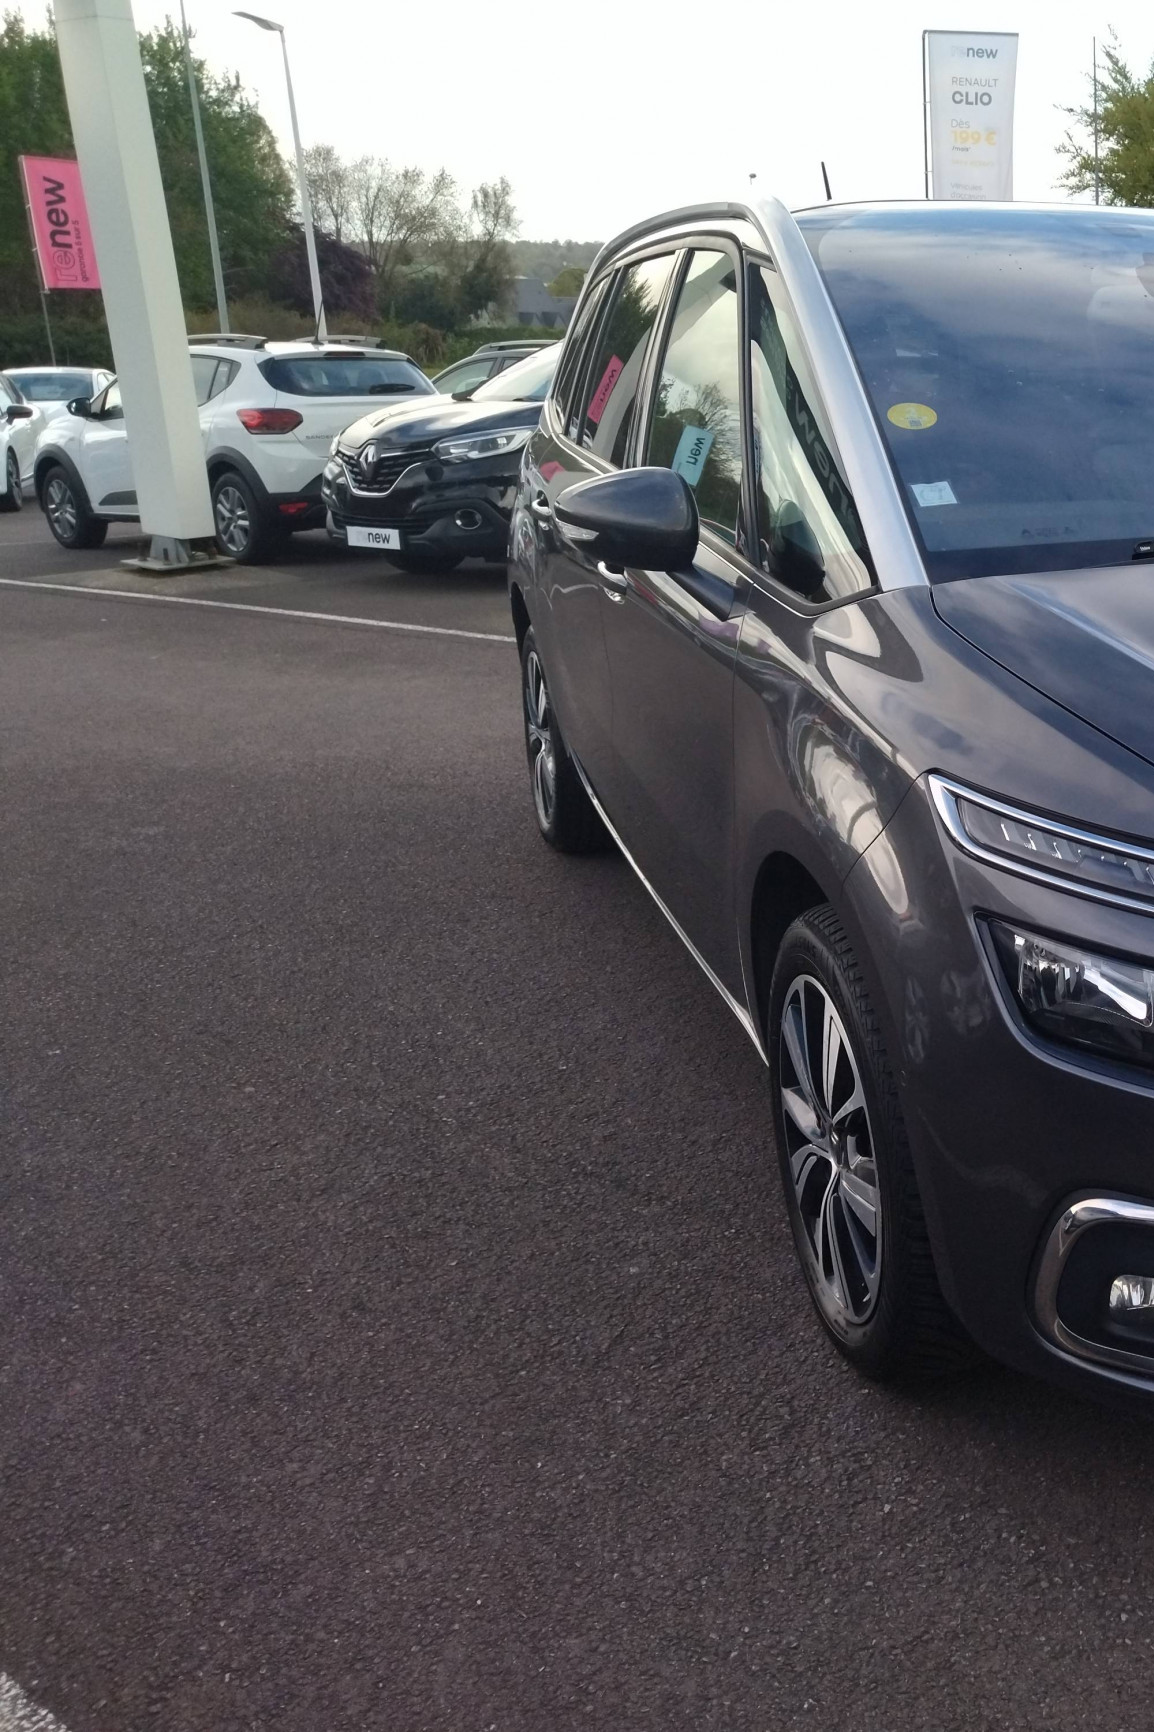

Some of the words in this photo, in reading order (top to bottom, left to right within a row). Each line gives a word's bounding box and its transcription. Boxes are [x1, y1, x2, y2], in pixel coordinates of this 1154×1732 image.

[951, 76, 999, 89] RENAULT
[951, 90, 993, 106] CLIO
[43, 175, 78, 282] renew
